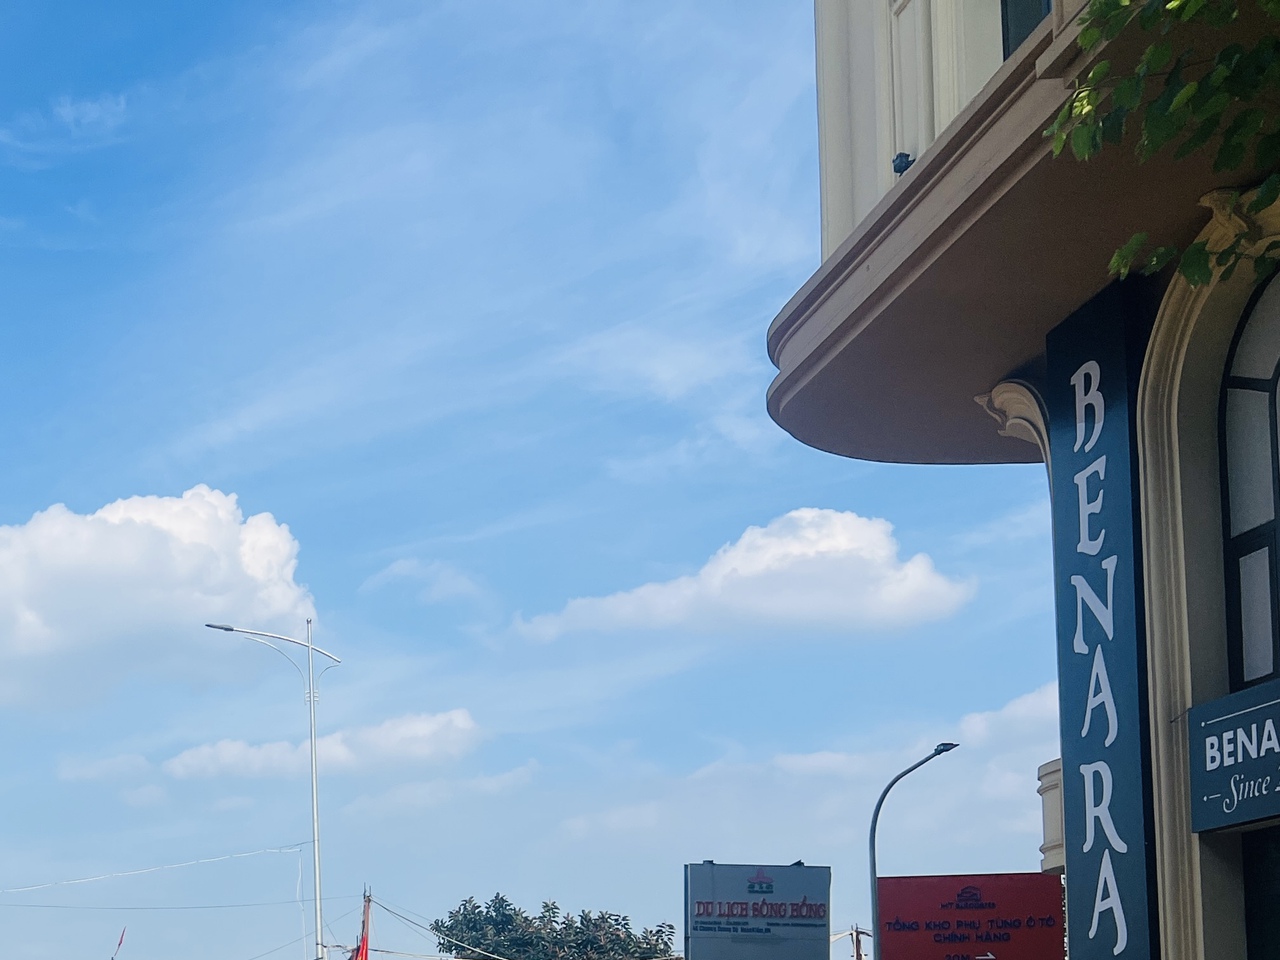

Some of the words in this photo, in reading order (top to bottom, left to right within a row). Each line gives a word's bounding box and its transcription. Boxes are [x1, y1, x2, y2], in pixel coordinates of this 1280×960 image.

[1222, 774, 1271, 814] Since
[695, 900, 714, 917] DU
[717, 901, 749, 919] LỊCH
[886, 916, 919, 931] TỔNG
[925, 920, 951, 931] KHO
[956, 920, 981, 931] PHỤ
[988, 916, 1022, 929] TÙNG
[1026, 915, 1036, 928] Ô
[1038, 915, 1056, 928] TÔ
[933, 932, 970, 943] CHÍNH
[975, 930, 1011, 942] HÀNG
